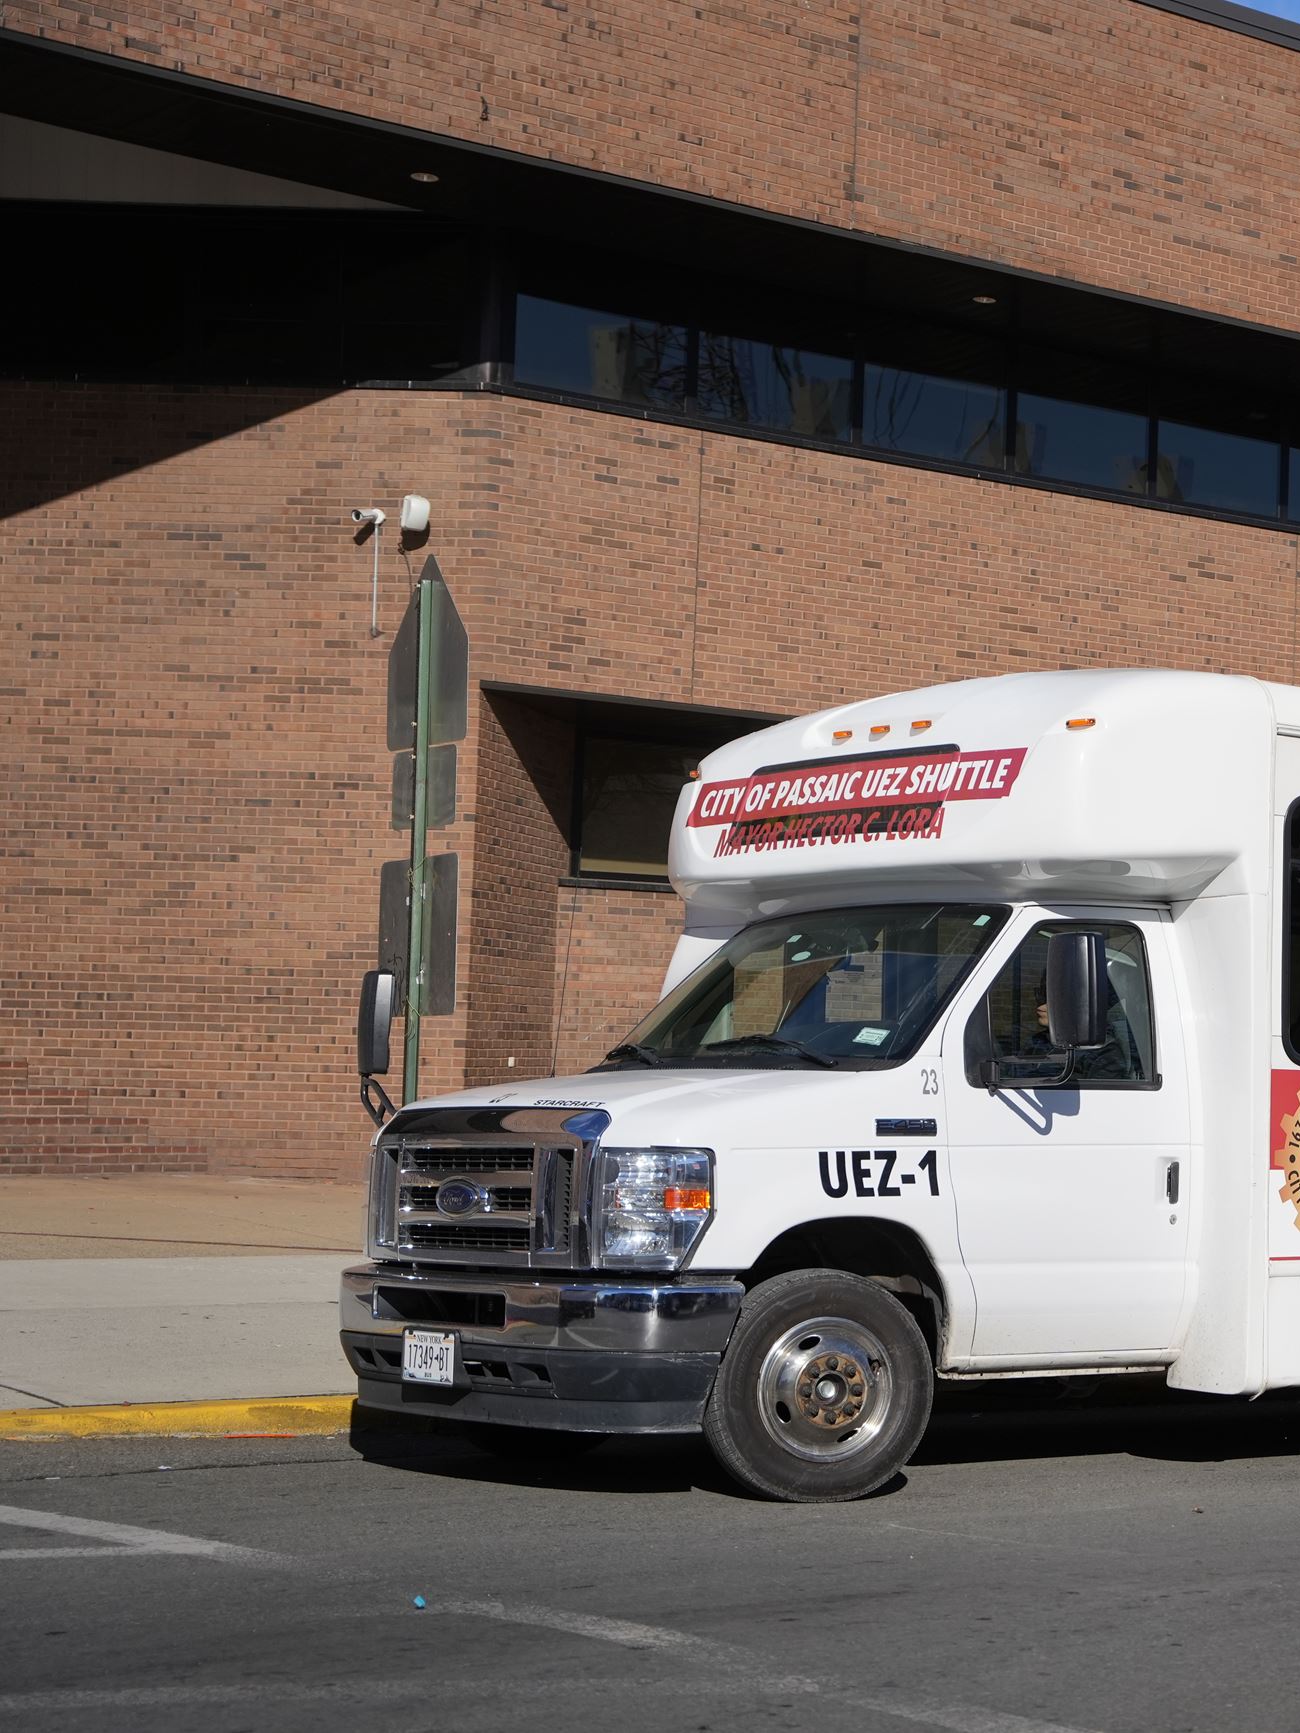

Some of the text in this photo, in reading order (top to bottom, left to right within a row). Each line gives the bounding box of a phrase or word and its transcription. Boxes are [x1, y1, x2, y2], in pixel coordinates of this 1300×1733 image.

[700, 758, 1012, 818] CITY OF PASSAIC UEZ SHUTTLE
[713, 807, 946, 858] MAYOR HECTOR C. LORA
[921, 1069, 939, 1095] 23
[533, 1099, 605, 1107] STARCRAFT
[818, 1150, 939, 1198] UEZ-1
[416, 1335, 443, 1344] NEW YORK
